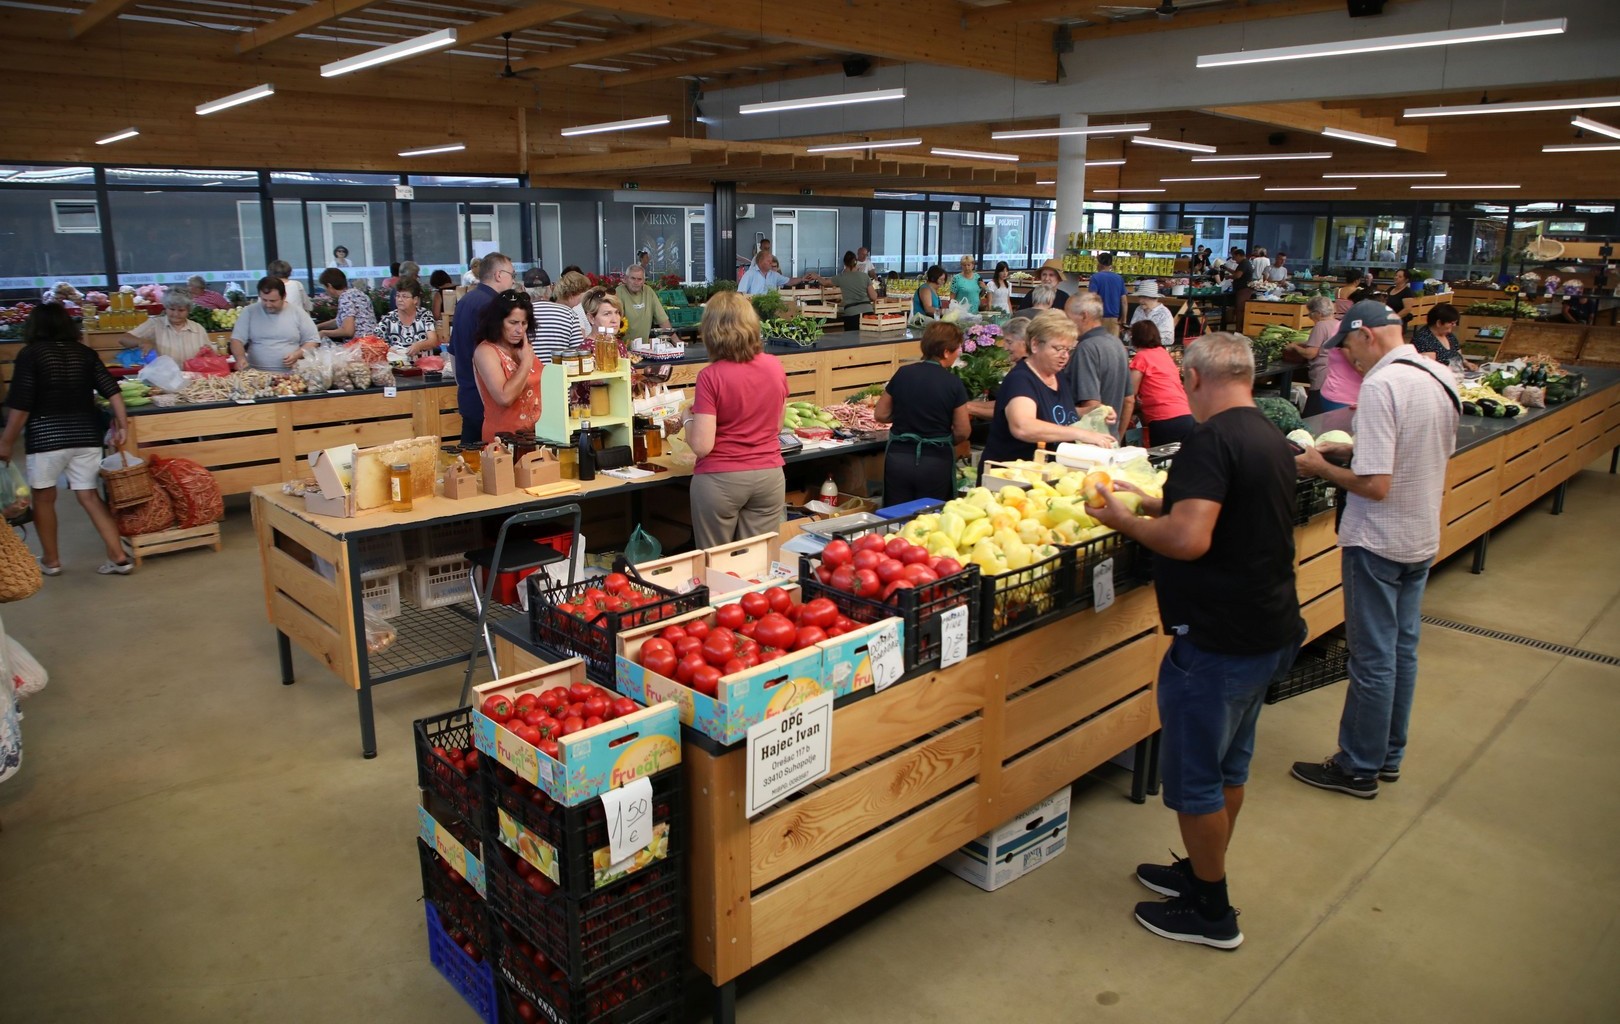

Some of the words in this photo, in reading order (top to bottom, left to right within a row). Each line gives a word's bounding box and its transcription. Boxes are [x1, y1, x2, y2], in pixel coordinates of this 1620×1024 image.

[877, 663, 889, 689] 2
[781, 712, 803, 733] OPG
[761, 737, 793, 760] Hajec
[796, 724, 820, 743] Ivan
[763, 770, 783, 787] 33410
[784, 753, 816, 776] Suhopolje
[772, 753, 795, 770] Orešac
[796, 746, 805, 759] 117
[612, 801, 623, 849] 1
[626, 798, 647, 824] 50
[630, 829, 640, 843] €
